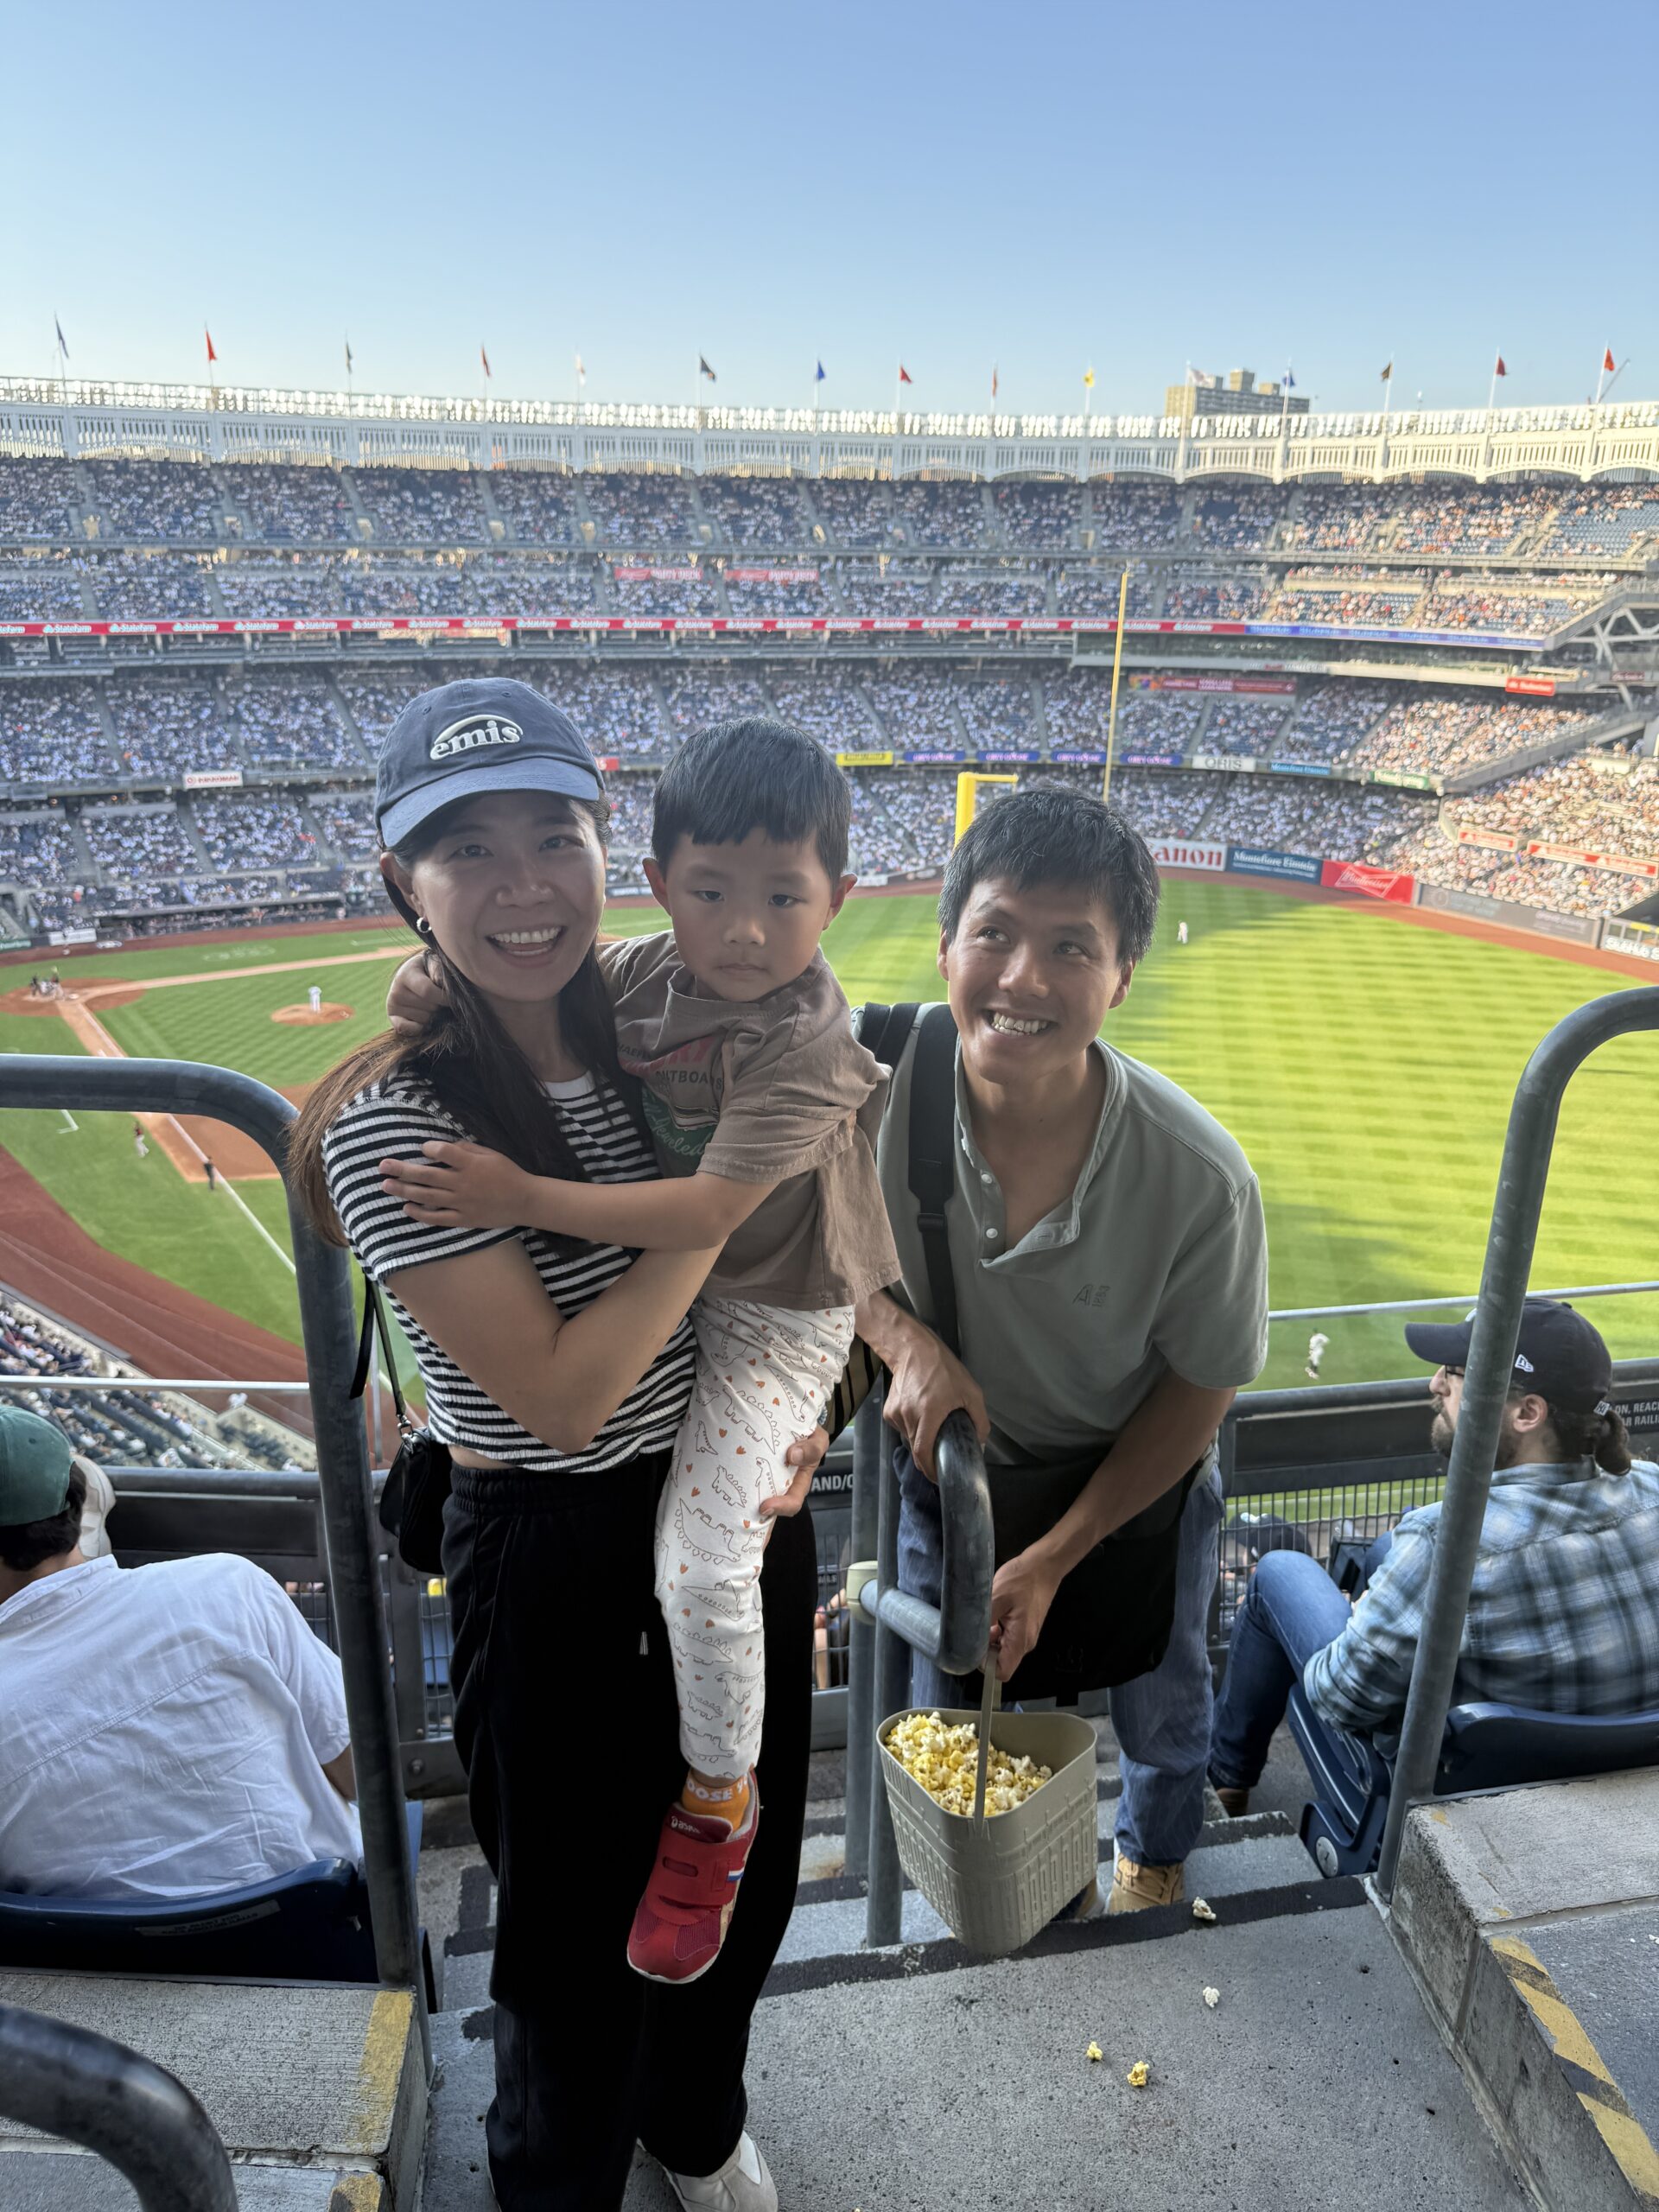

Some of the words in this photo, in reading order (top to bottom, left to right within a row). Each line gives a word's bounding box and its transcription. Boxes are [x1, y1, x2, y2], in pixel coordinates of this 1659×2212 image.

[430, 720, 520, 760] emis
[1205, 757, 1242, 771] ORIS
[1154, 847, 1222, 867] anon
[1234, 851, 1282, 867] Montefiore
